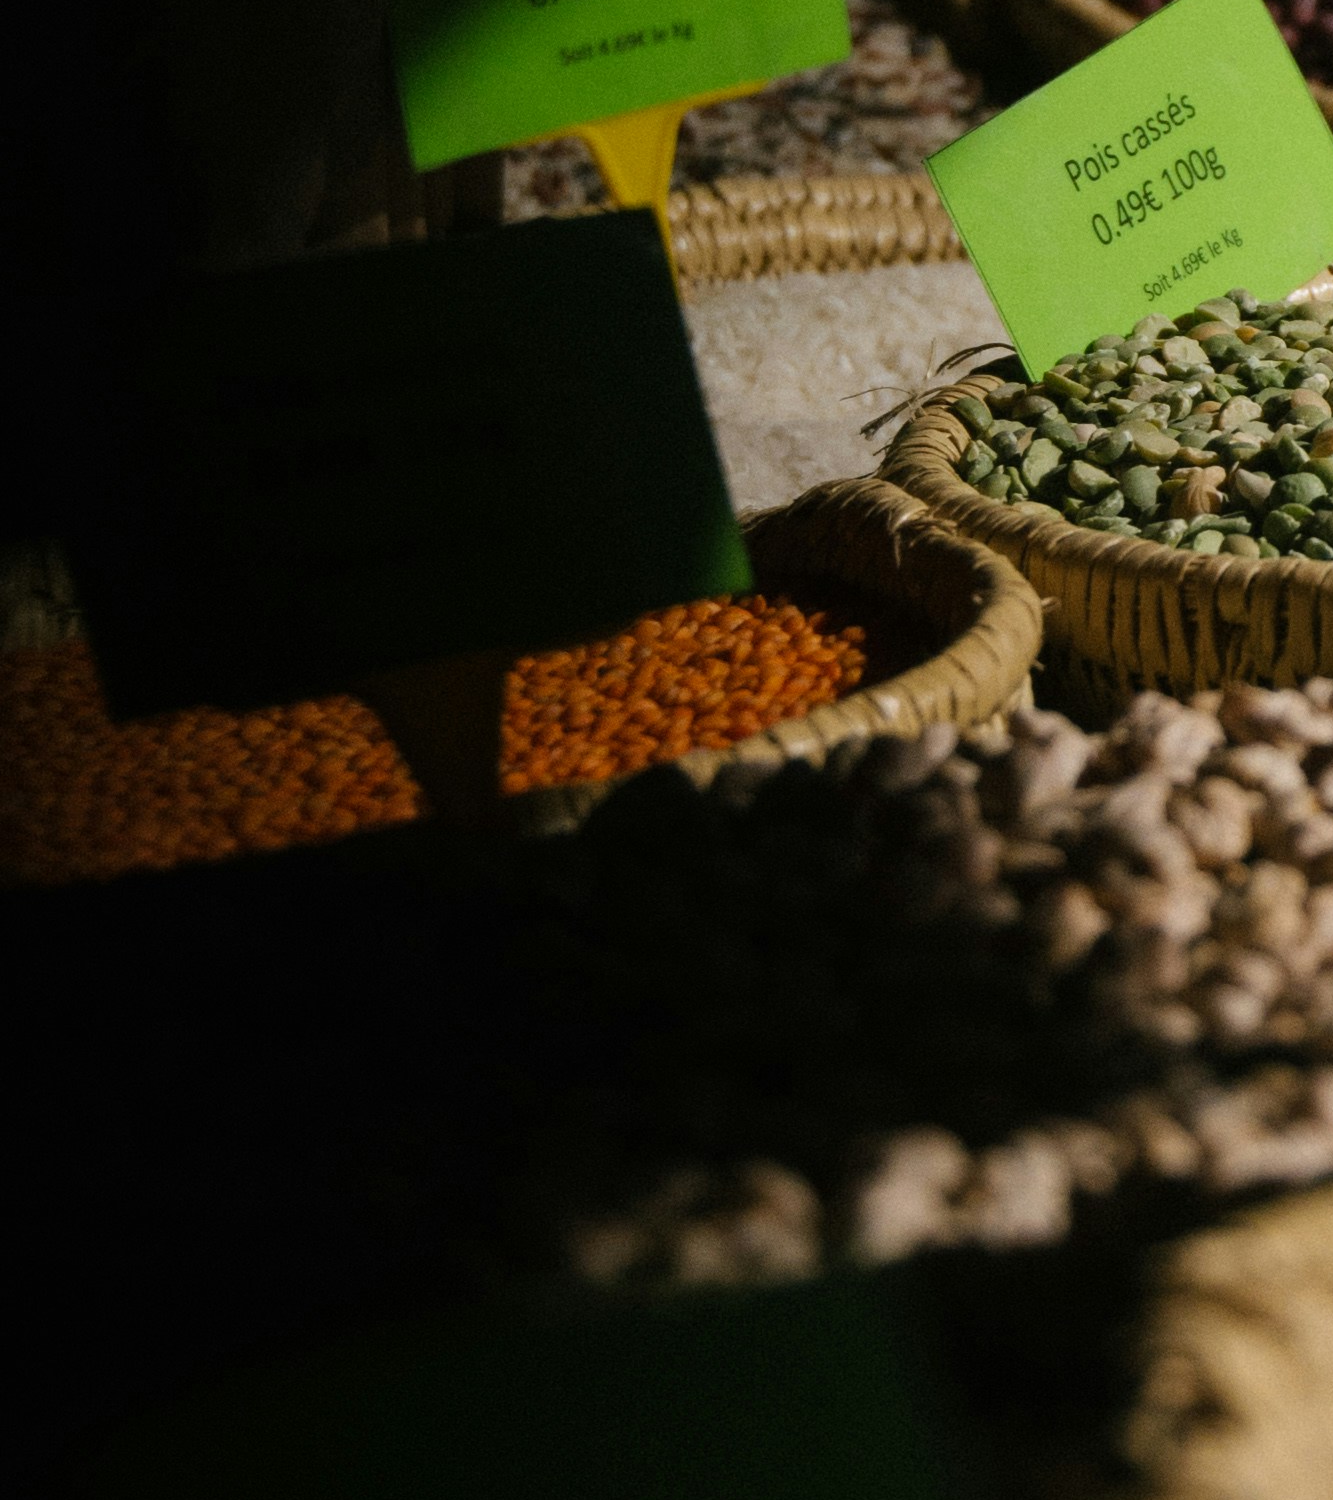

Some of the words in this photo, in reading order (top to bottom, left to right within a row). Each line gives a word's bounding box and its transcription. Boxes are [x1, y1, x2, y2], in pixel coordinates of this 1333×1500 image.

[1064, 143, 1119, 191] Pois
[1121, 92, 1197, 158] cassés
[1091, 180, 1164, 246] 0.49€
[1161, 144, 1226, 200] 100g
[1142, 273, 1172, 302] Soit
[1171, 248, 1209, 283] 4.69€
[1207, 240, 1222, 257] le
[1221, 226, 1244, 251] Kg
